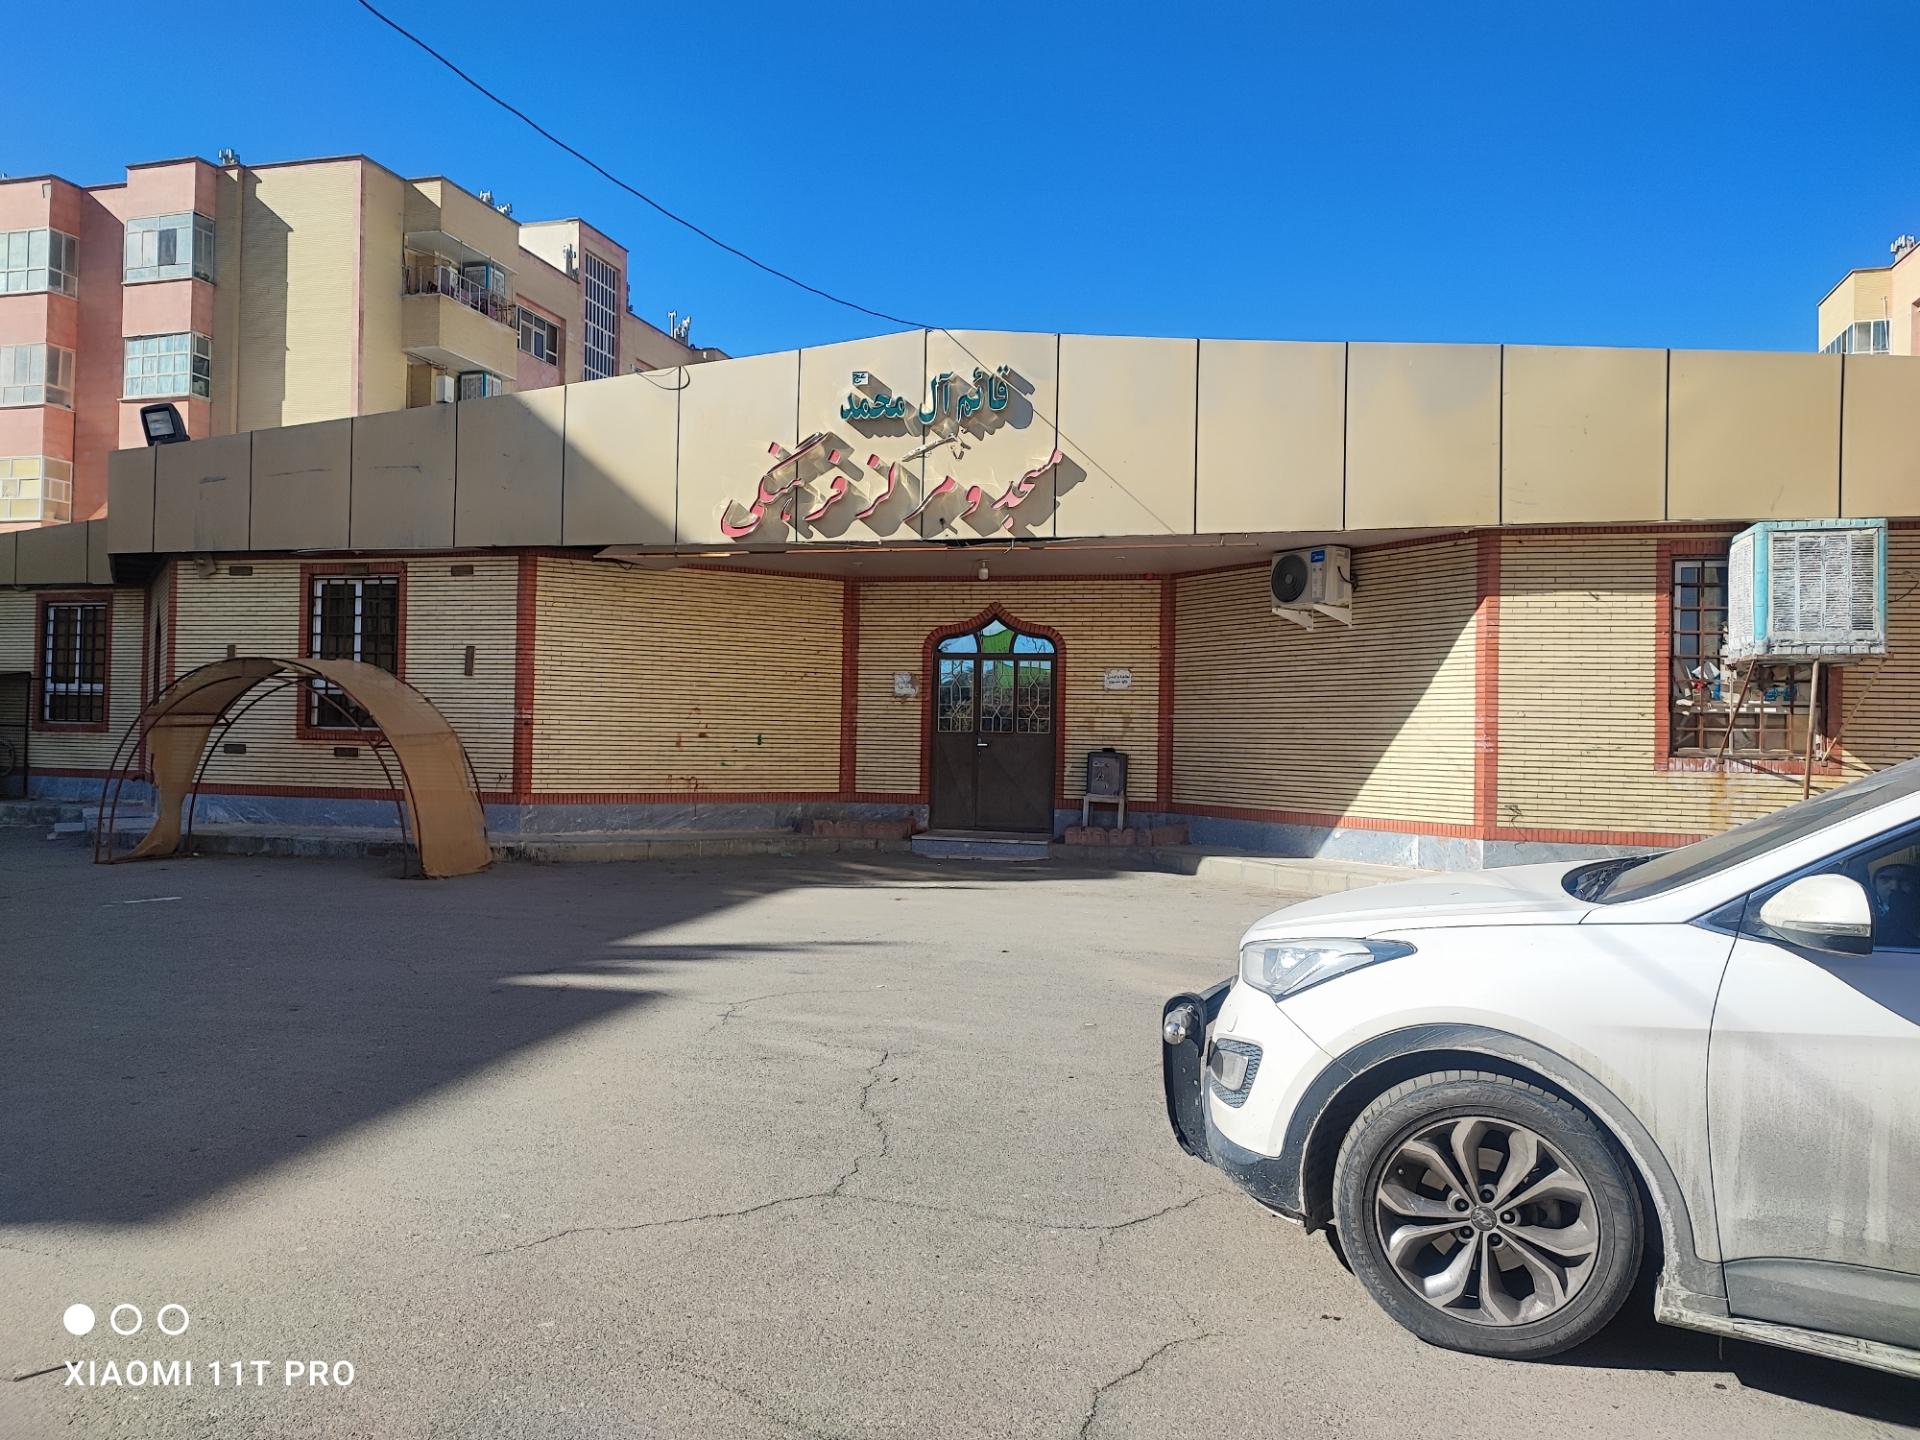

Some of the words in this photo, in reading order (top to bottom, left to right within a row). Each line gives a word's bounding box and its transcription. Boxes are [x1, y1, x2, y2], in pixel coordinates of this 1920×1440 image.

[840, 392, 906, 420] محمد
[918, 371, 954, 425] آل
[957, 363, 1009, 424] قائم
[960, 485, 982, 518] و
[992, 448, 1063, 530] مسجد
